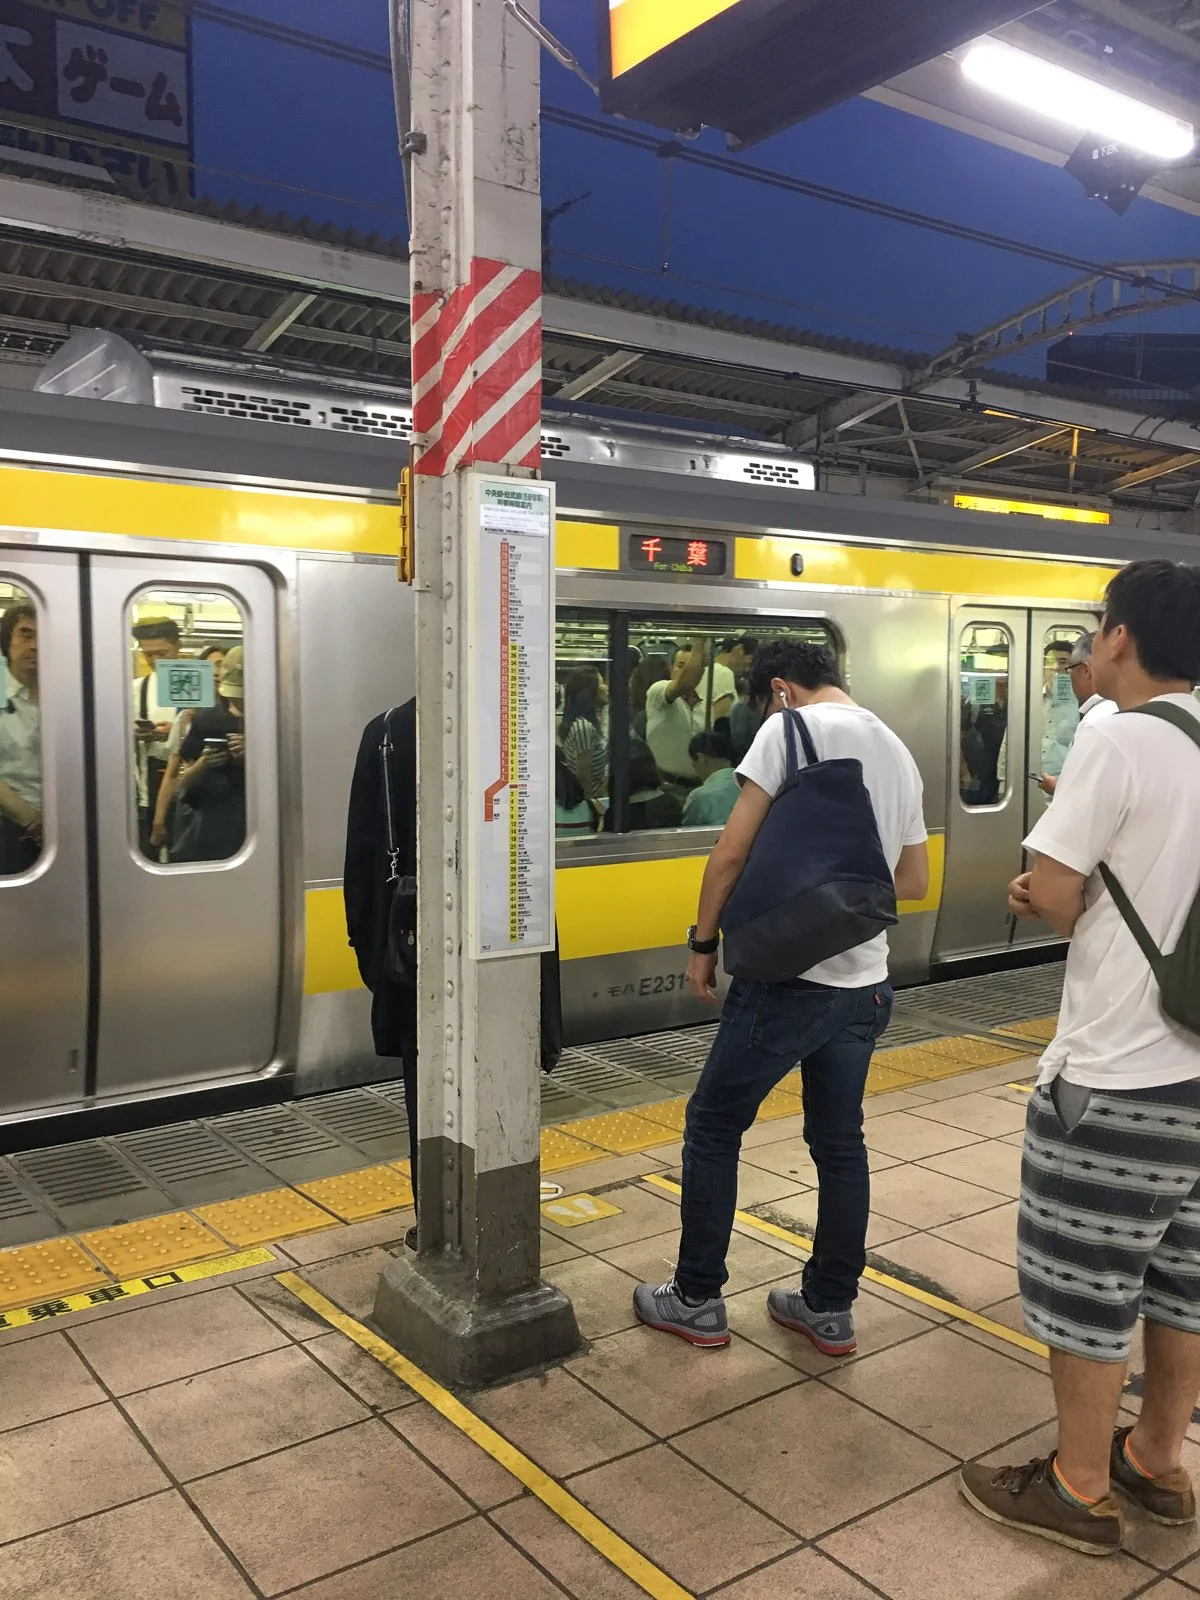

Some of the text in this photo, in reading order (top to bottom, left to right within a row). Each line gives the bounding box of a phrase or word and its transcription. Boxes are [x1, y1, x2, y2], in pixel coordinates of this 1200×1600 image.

[63, 44, 182, 127] ゲーム
[641, 538, 708, 566] 千葉
[607, 983, 636, 998] モハ
